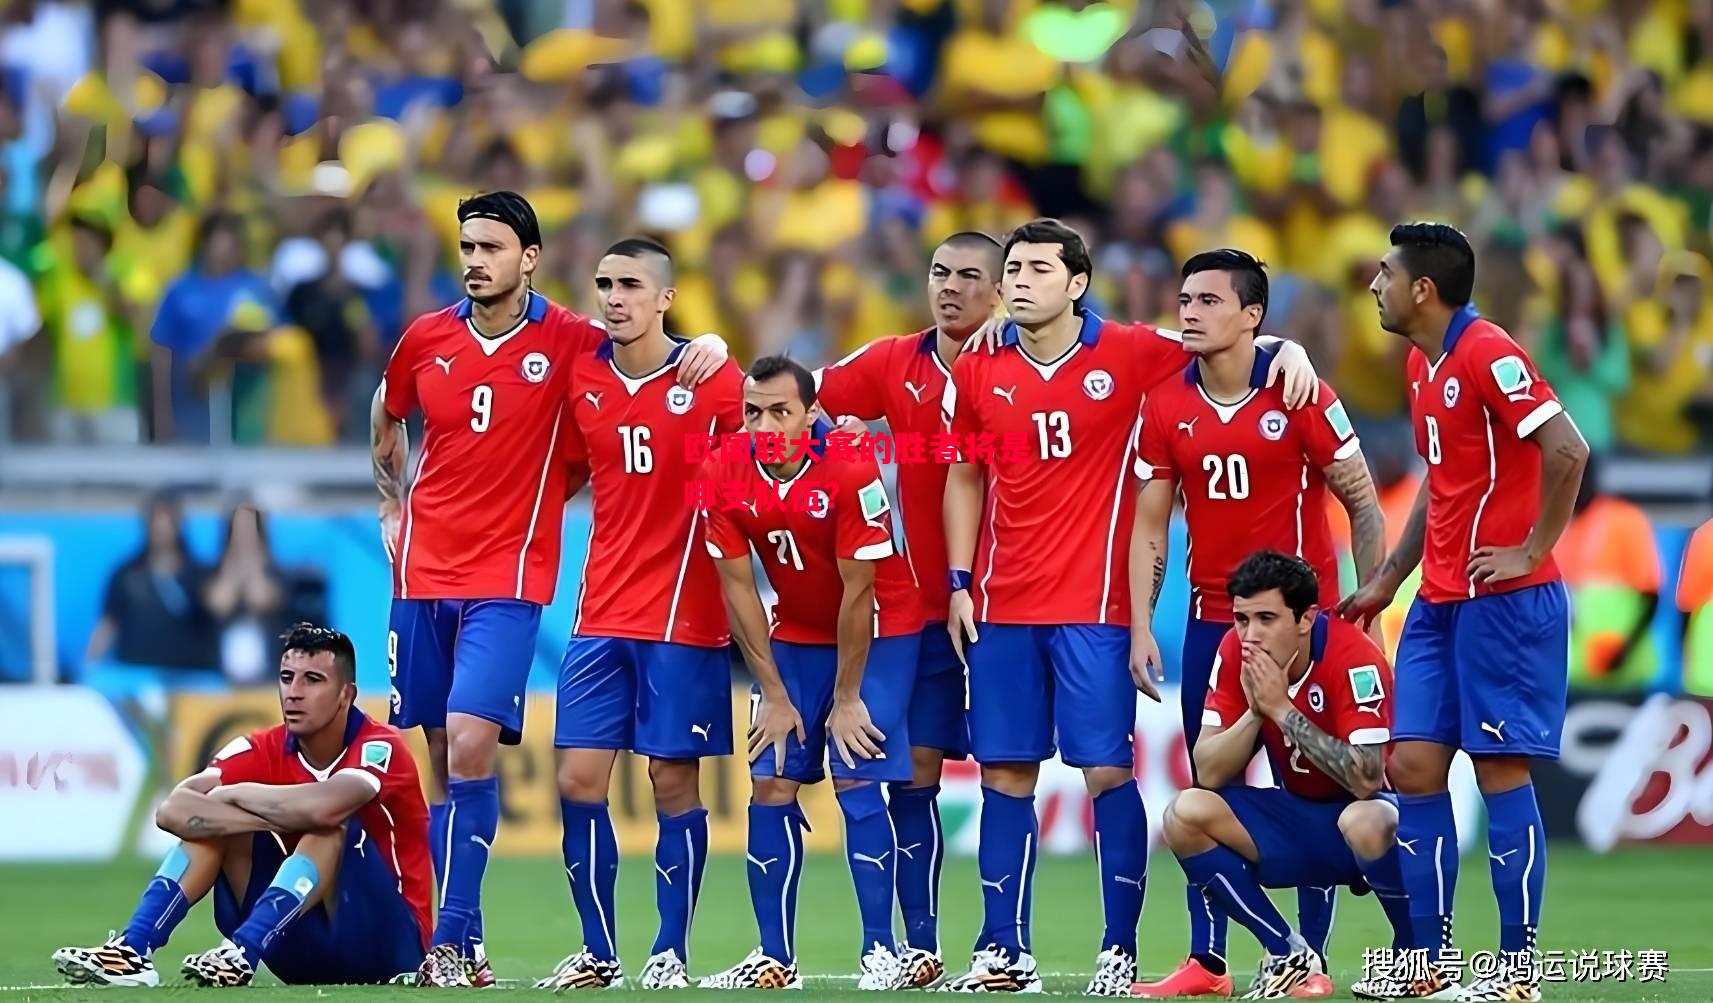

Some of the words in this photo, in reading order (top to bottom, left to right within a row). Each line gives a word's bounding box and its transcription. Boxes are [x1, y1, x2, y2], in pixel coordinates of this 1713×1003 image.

[471, 385, 493, 433] 9
[617, 426, 653, 474] 16
[1031, 410, 1072, 460] 13
[1202, 453, 1249, 500] 20
